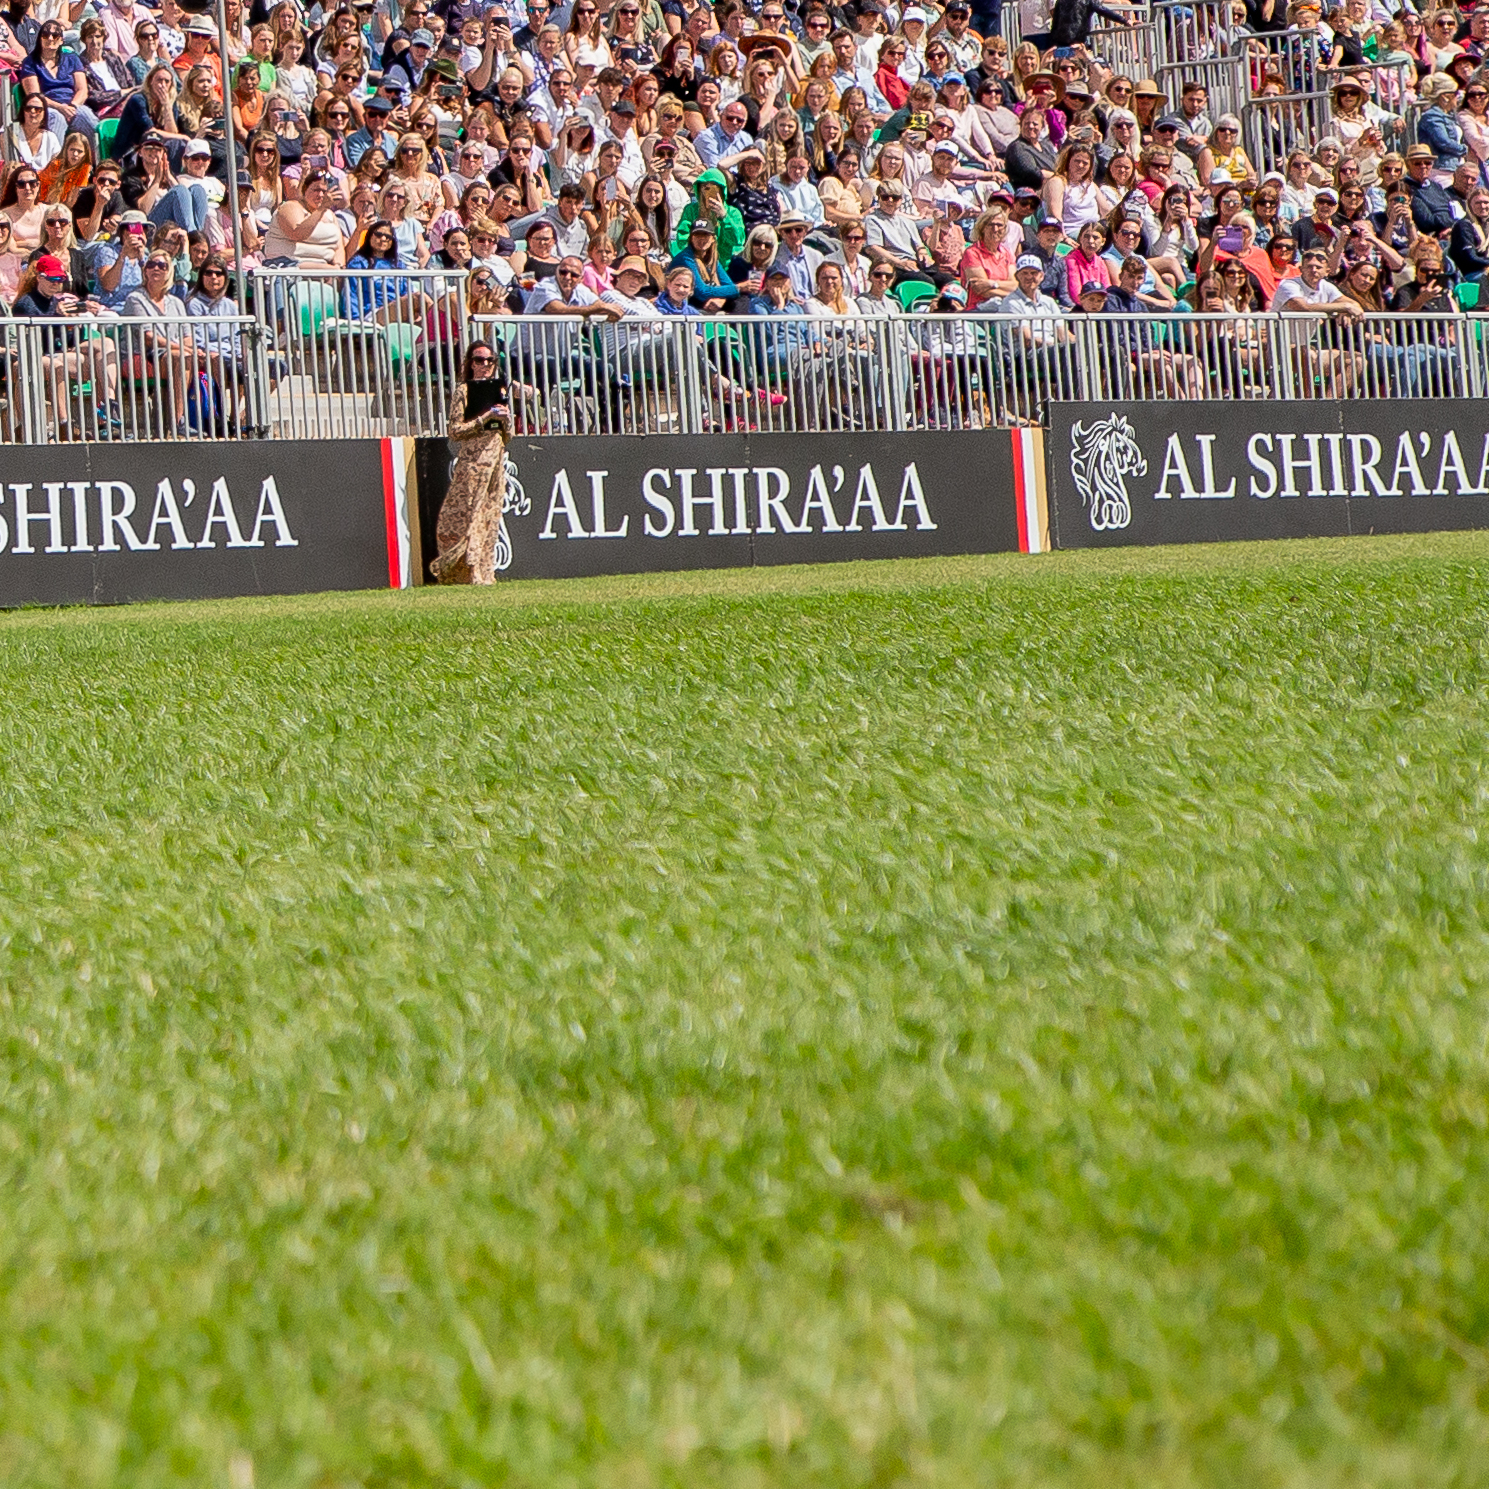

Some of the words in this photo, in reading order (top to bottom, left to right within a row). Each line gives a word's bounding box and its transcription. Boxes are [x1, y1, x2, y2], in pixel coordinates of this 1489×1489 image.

[538, 468, 629, 539] AL
[642, 461, 938, 539] SHIRA'AA
[1153, 431, 1236, 499] AL
